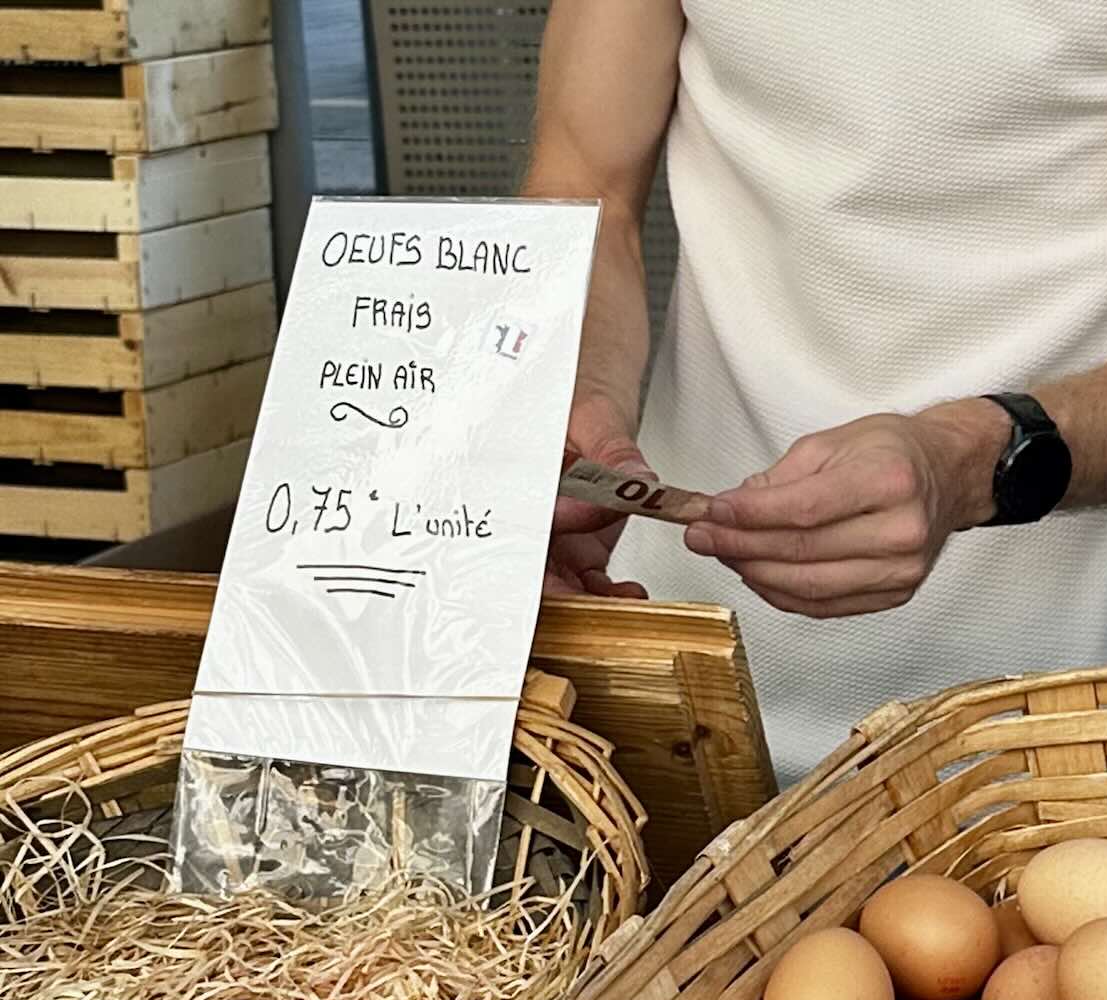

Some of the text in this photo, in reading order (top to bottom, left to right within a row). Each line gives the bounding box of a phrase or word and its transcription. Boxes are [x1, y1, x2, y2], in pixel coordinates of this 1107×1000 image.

[322, 231, 531, 275] OEUFS BLANC
[391, 503, 493, 538] L'unité
